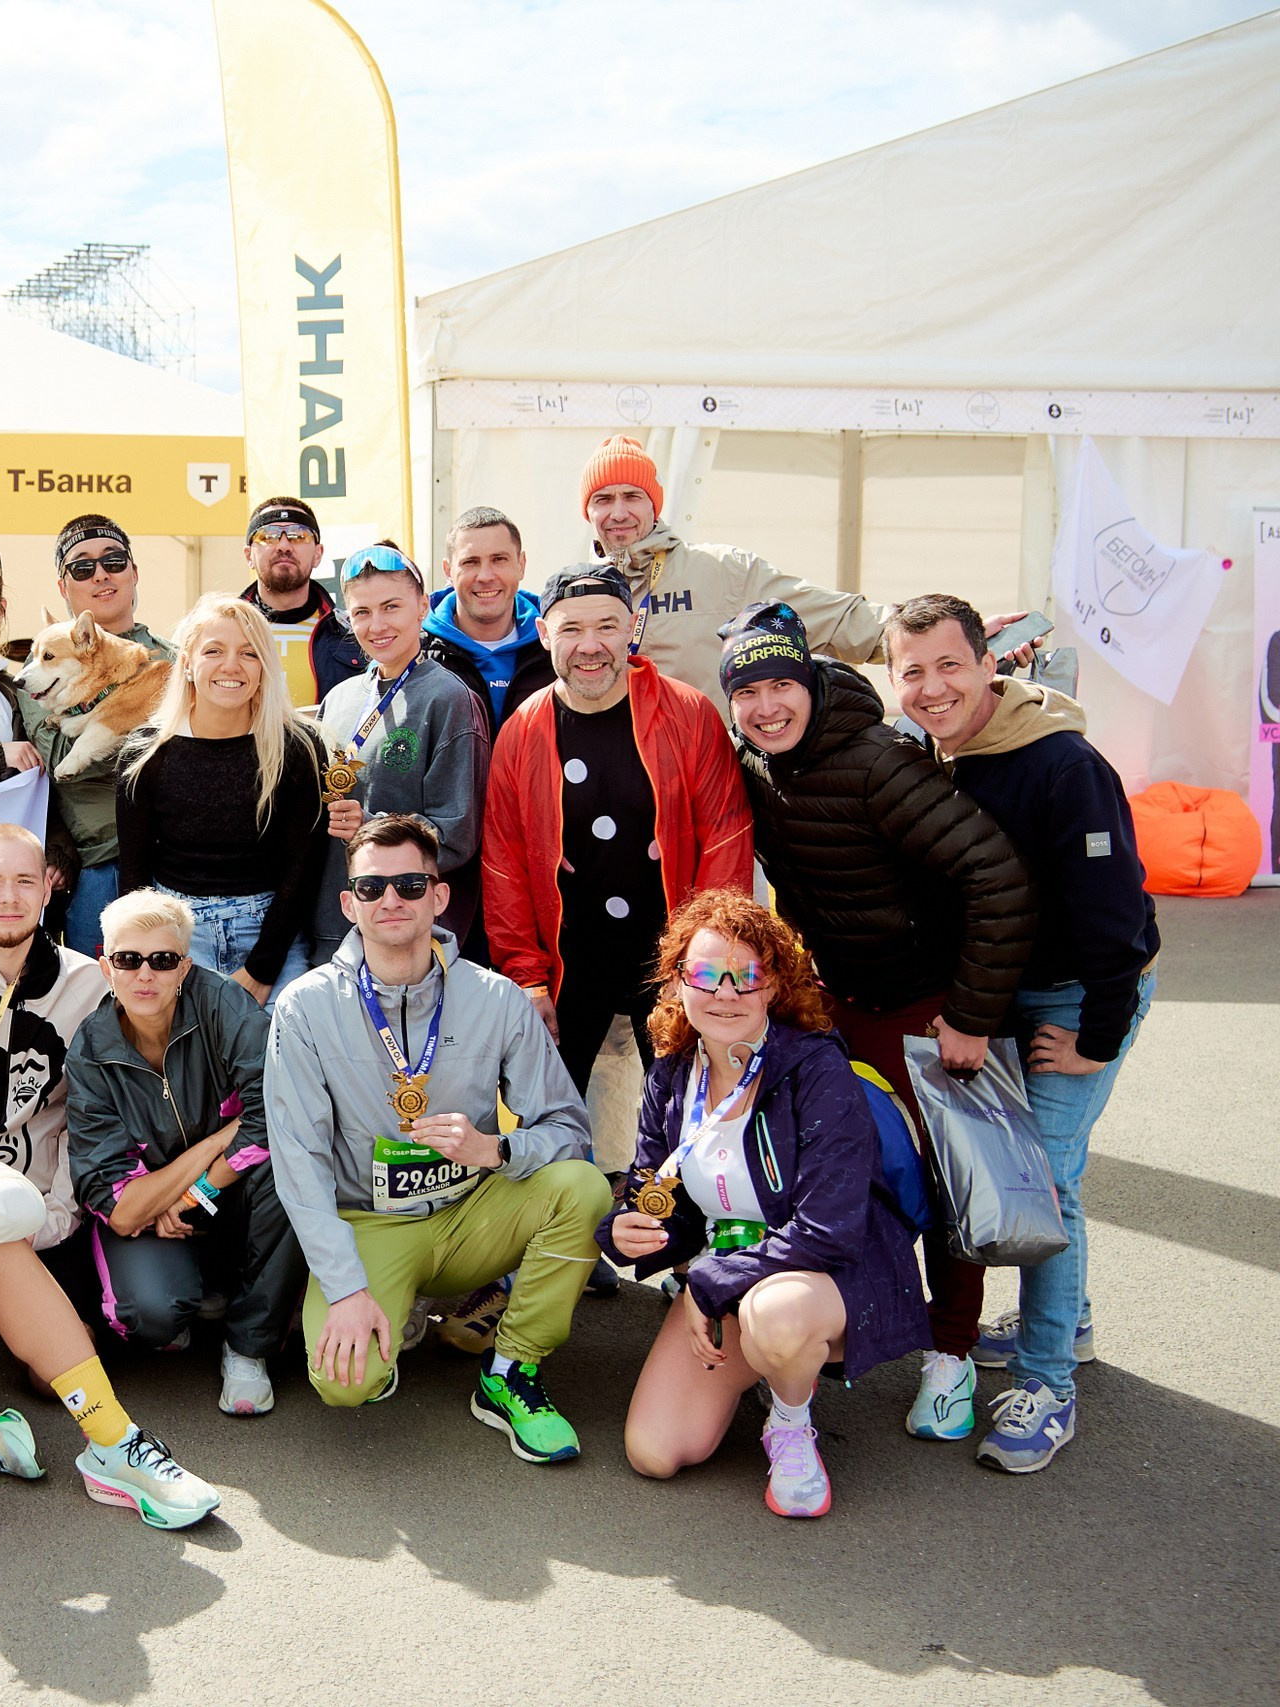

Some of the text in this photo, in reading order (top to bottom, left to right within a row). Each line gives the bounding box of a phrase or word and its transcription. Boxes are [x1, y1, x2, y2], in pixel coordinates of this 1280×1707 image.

[7, 469, 132, 493] Т-Банка
[1106, 536, 1160, 587] БЕГОИН
[650, 589, 693, 615] HH
[733, 634, 794, 655] SURPRISE
[734, 645, 804, 669] SURPRISE!
[1262, 727, 1280, 740] УС
[384, 1034, 403, 1063] 10 KM
[375, 1176, 386, 1187] D
[395, 1162, 463, 1192] 29608
[407, 1182, 451, 1197] ALEKSANDR
